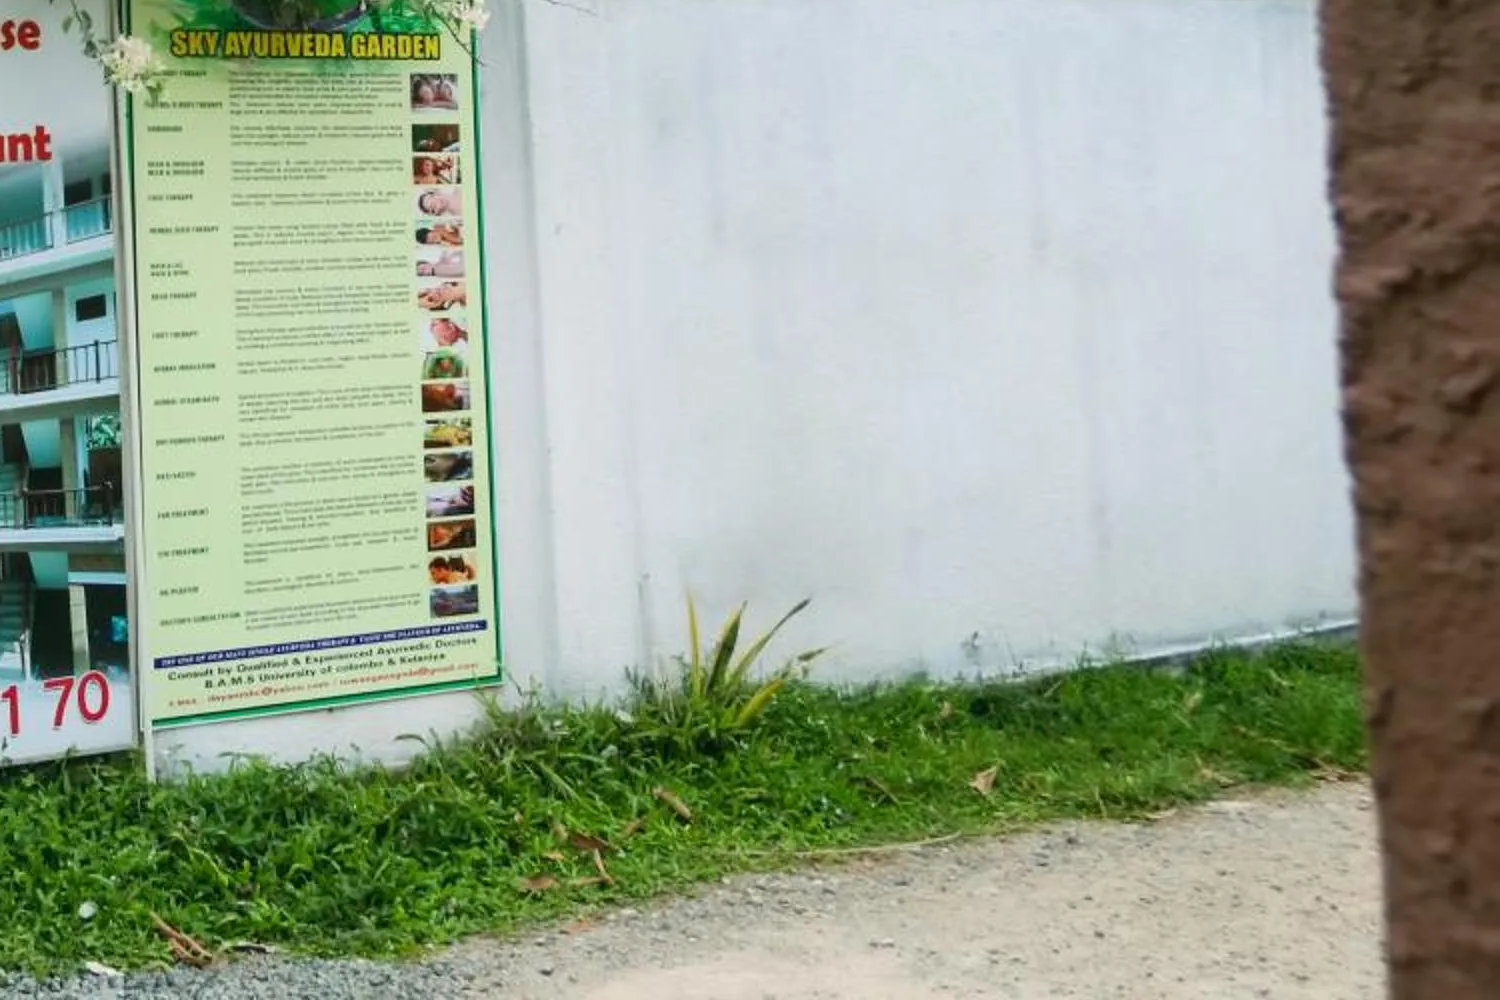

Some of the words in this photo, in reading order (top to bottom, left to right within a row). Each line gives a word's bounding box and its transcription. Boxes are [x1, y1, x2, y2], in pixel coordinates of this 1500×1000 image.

[170, 28, 219, 59] SKY
[224, 29, 346, 59] AYURVEDA
[350, 32, 442, 61] GARDEN
[217, 665, 232, 676] by
[258, 667, 317, 684] University
[42, 670, 112, 730] 70
